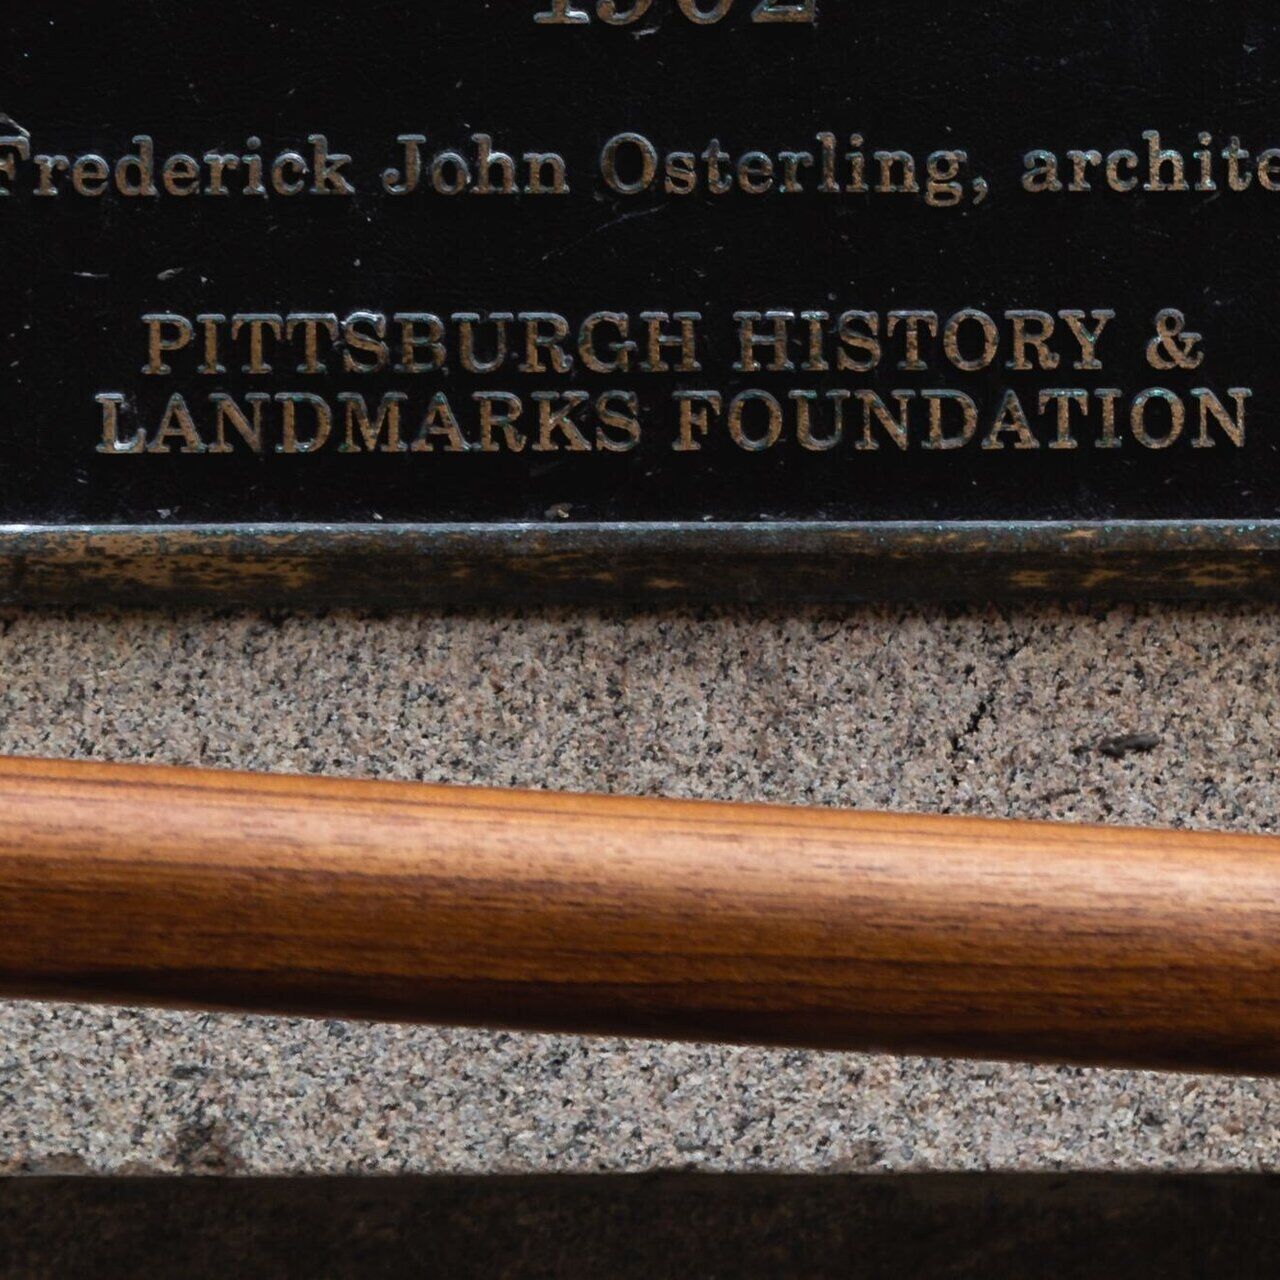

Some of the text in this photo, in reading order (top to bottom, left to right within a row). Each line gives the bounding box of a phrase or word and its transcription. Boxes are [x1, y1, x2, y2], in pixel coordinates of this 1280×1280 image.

[380, 130, 569, 198] John
[601, 128, 990, 208] Osterling,
[140, 306, 1206, 375] PITTSBURGH HISTORY &
[93, 387, 1254, 456] LANDMARKS FOUNDATION
